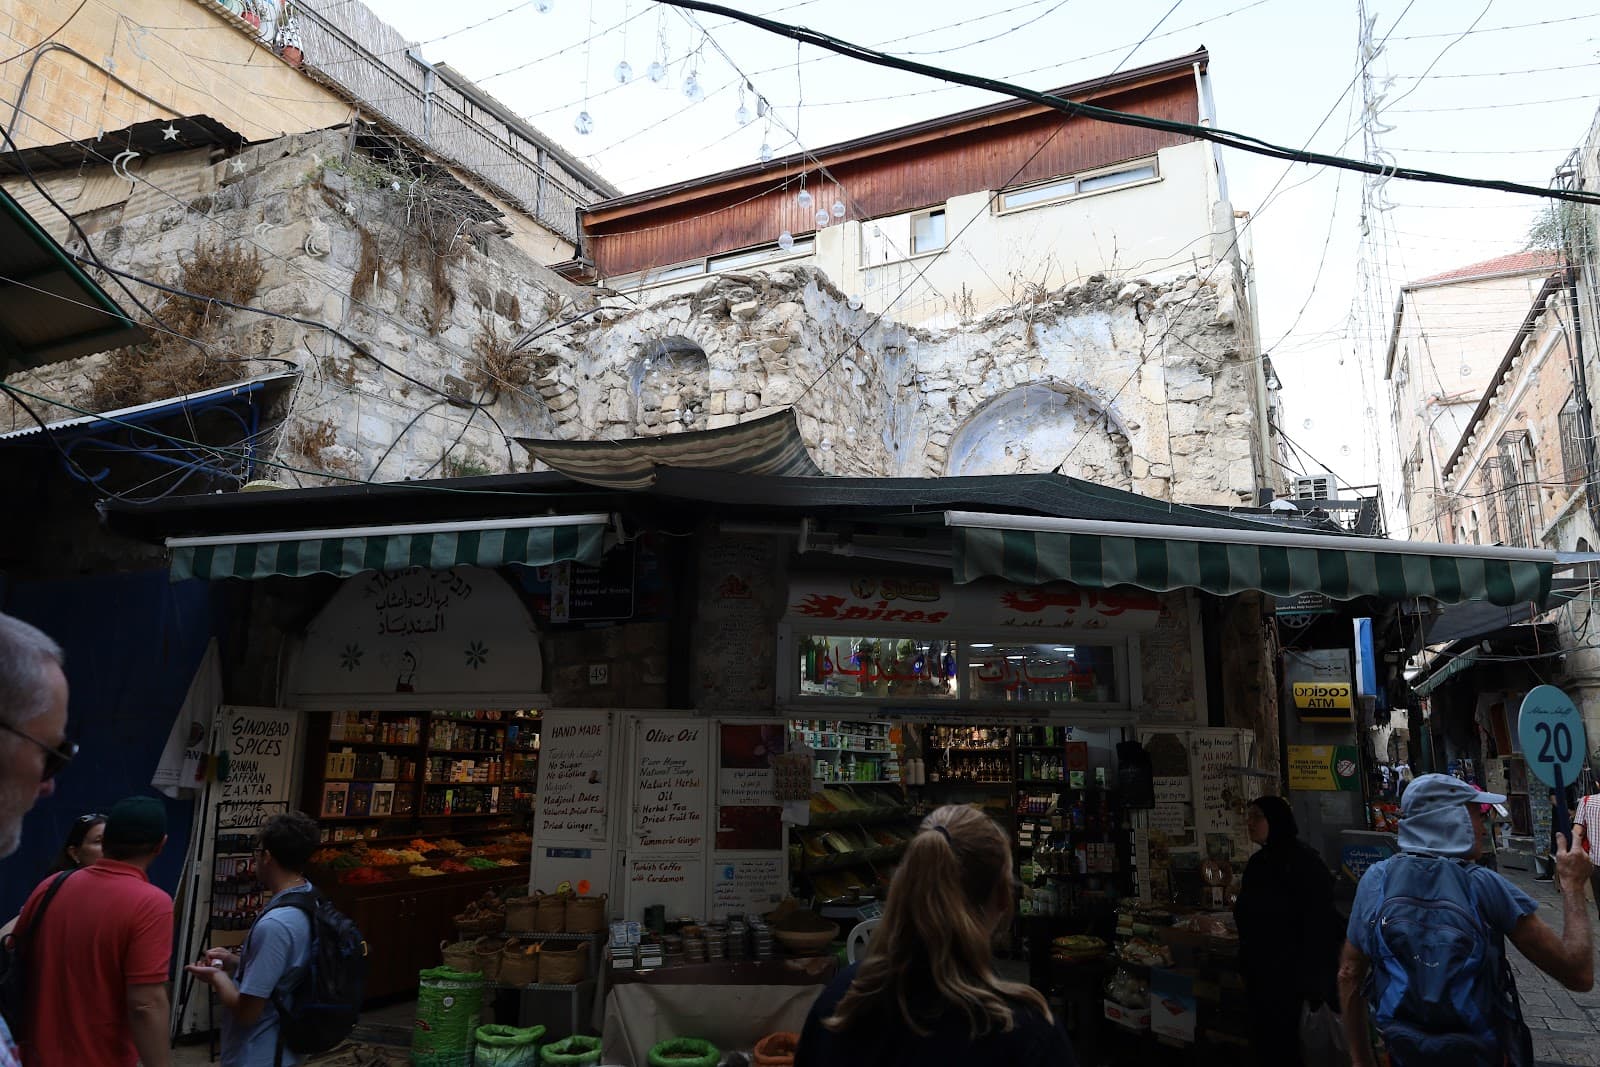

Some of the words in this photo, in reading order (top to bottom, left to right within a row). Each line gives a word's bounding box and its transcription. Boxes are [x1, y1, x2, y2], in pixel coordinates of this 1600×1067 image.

[591, 669, 607, 681] 49
[1294, 686, 1349, 697] כספומט
[1308, 698, 1335, 707] ATM
[232, 716, 289, 737] SINDIBAD
[552, 725, 576, 738] HAND
[578, 724, 602, 736] MADE
[646, 729, 674, 743] Olive
[678, 728, 698, 742] Oil
[234, 736, 282, 757] SPICES
[1535, 722, 1572, 763] 20
[657, 790, 673, 802] Oil
[642, 803, 668, 814] Herbal
[672, 802, 687, 811] Tea
[641, 814, 666, 825] Dried
[544, 820, 564, 830] Dried
[566, 821, 593, 833] Ginger
